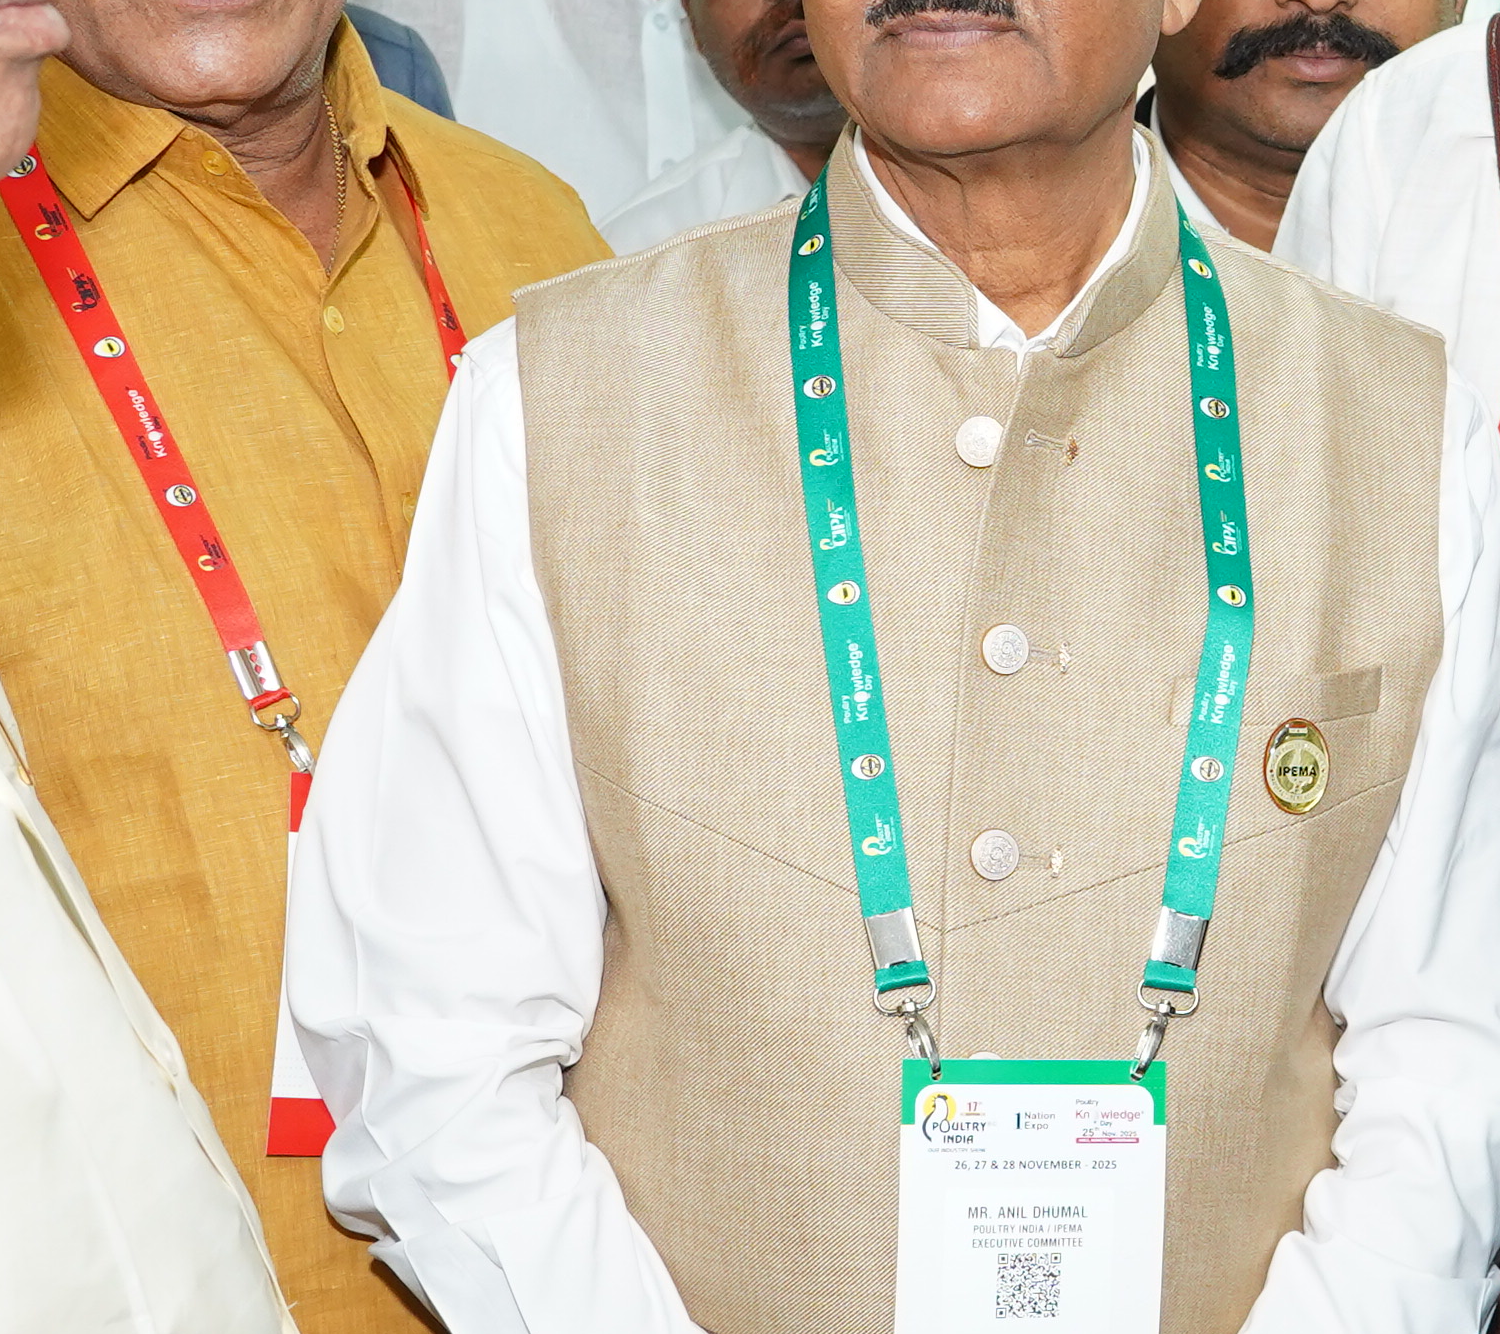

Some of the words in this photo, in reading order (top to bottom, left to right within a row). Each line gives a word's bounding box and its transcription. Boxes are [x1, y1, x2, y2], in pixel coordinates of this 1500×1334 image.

[1278, 766, 1317, 777] IPEMA
[1024, 1112, 1056, 1120] Nation
[1075, 1110, 1141, 1122] Knwledge
[932, 1119, 987, 1133] POULTRY
[1024, 1121, 1049, 1130] Expo
[943, 1135, 974, 1144] INDIA
[955, 1160, 971, 1171] 26,
[974, 1160, 987, 1170] 27
[990, 1160, 999, 1170] &
[1002, 1160, 1016, 1170] 28
[1018, 1160, 1082, 1170] NOVEMBER
[1091, 1160, 1118, 1170] 2025
[968, 1206, 992, 1219] MR.
[998, 1206, 1028, 1219] ANIL
[1033, 1205, 1089, 1219] DHUMAL
[973, 1224, 1016, 1234] POULTRY
[1019, 1224, 1044, 1234] INDIA
[1054, 1224, 1083, 1233] IPEMA
[972, 1238, 1024, 1249] EXECUTIVE
[1027, 1237, 1083, 1248] COMMITTEE
